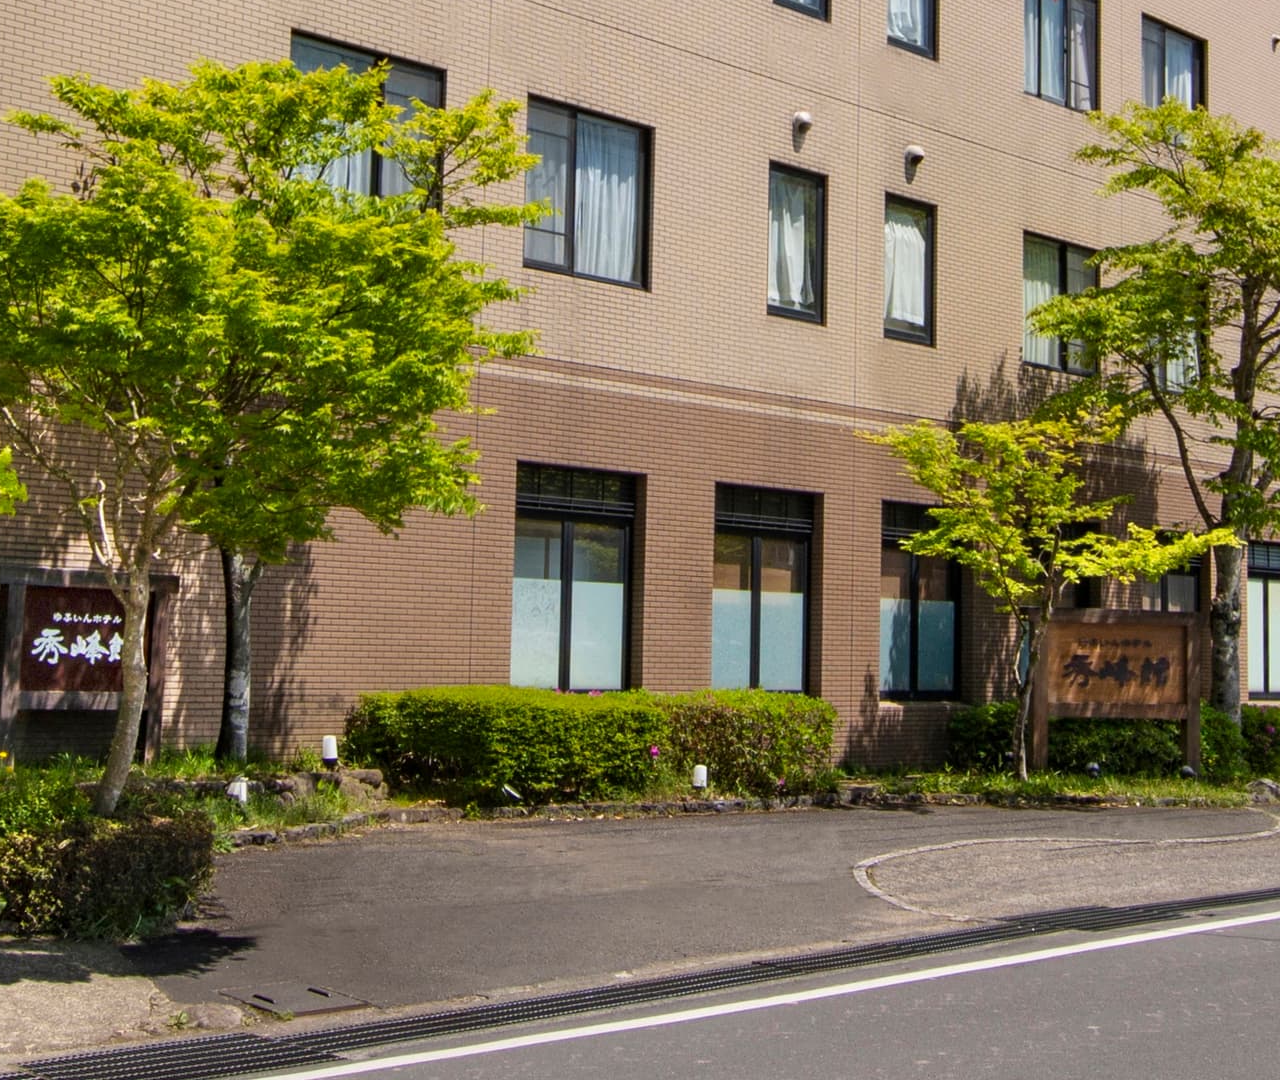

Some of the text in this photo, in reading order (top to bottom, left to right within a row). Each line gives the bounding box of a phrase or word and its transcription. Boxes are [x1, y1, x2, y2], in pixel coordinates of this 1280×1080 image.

[52, 612, 122, 624] ゆふいんホテル
